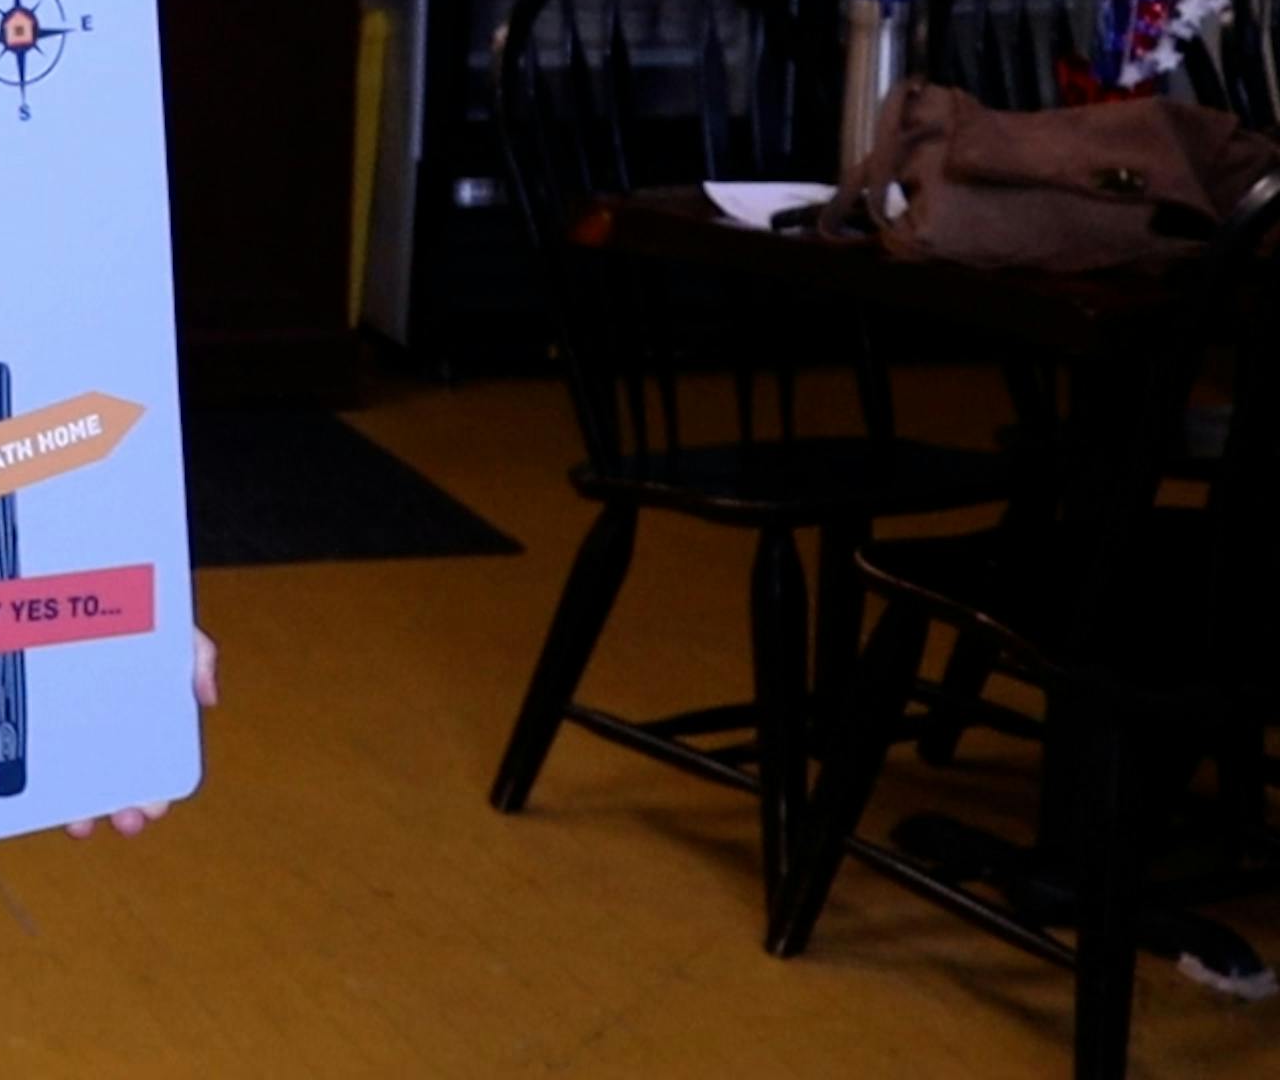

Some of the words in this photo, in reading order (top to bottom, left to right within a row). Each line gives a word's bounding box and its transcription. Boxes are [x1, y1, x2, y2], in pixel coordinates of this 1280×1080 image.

[80, 14, 93, 32] E
[19, 104, 31, 121] S
[37, 413, 103, 454] HOME
[11, 598, 60, 623] YES
[67, 595, 122, 618] TO...
